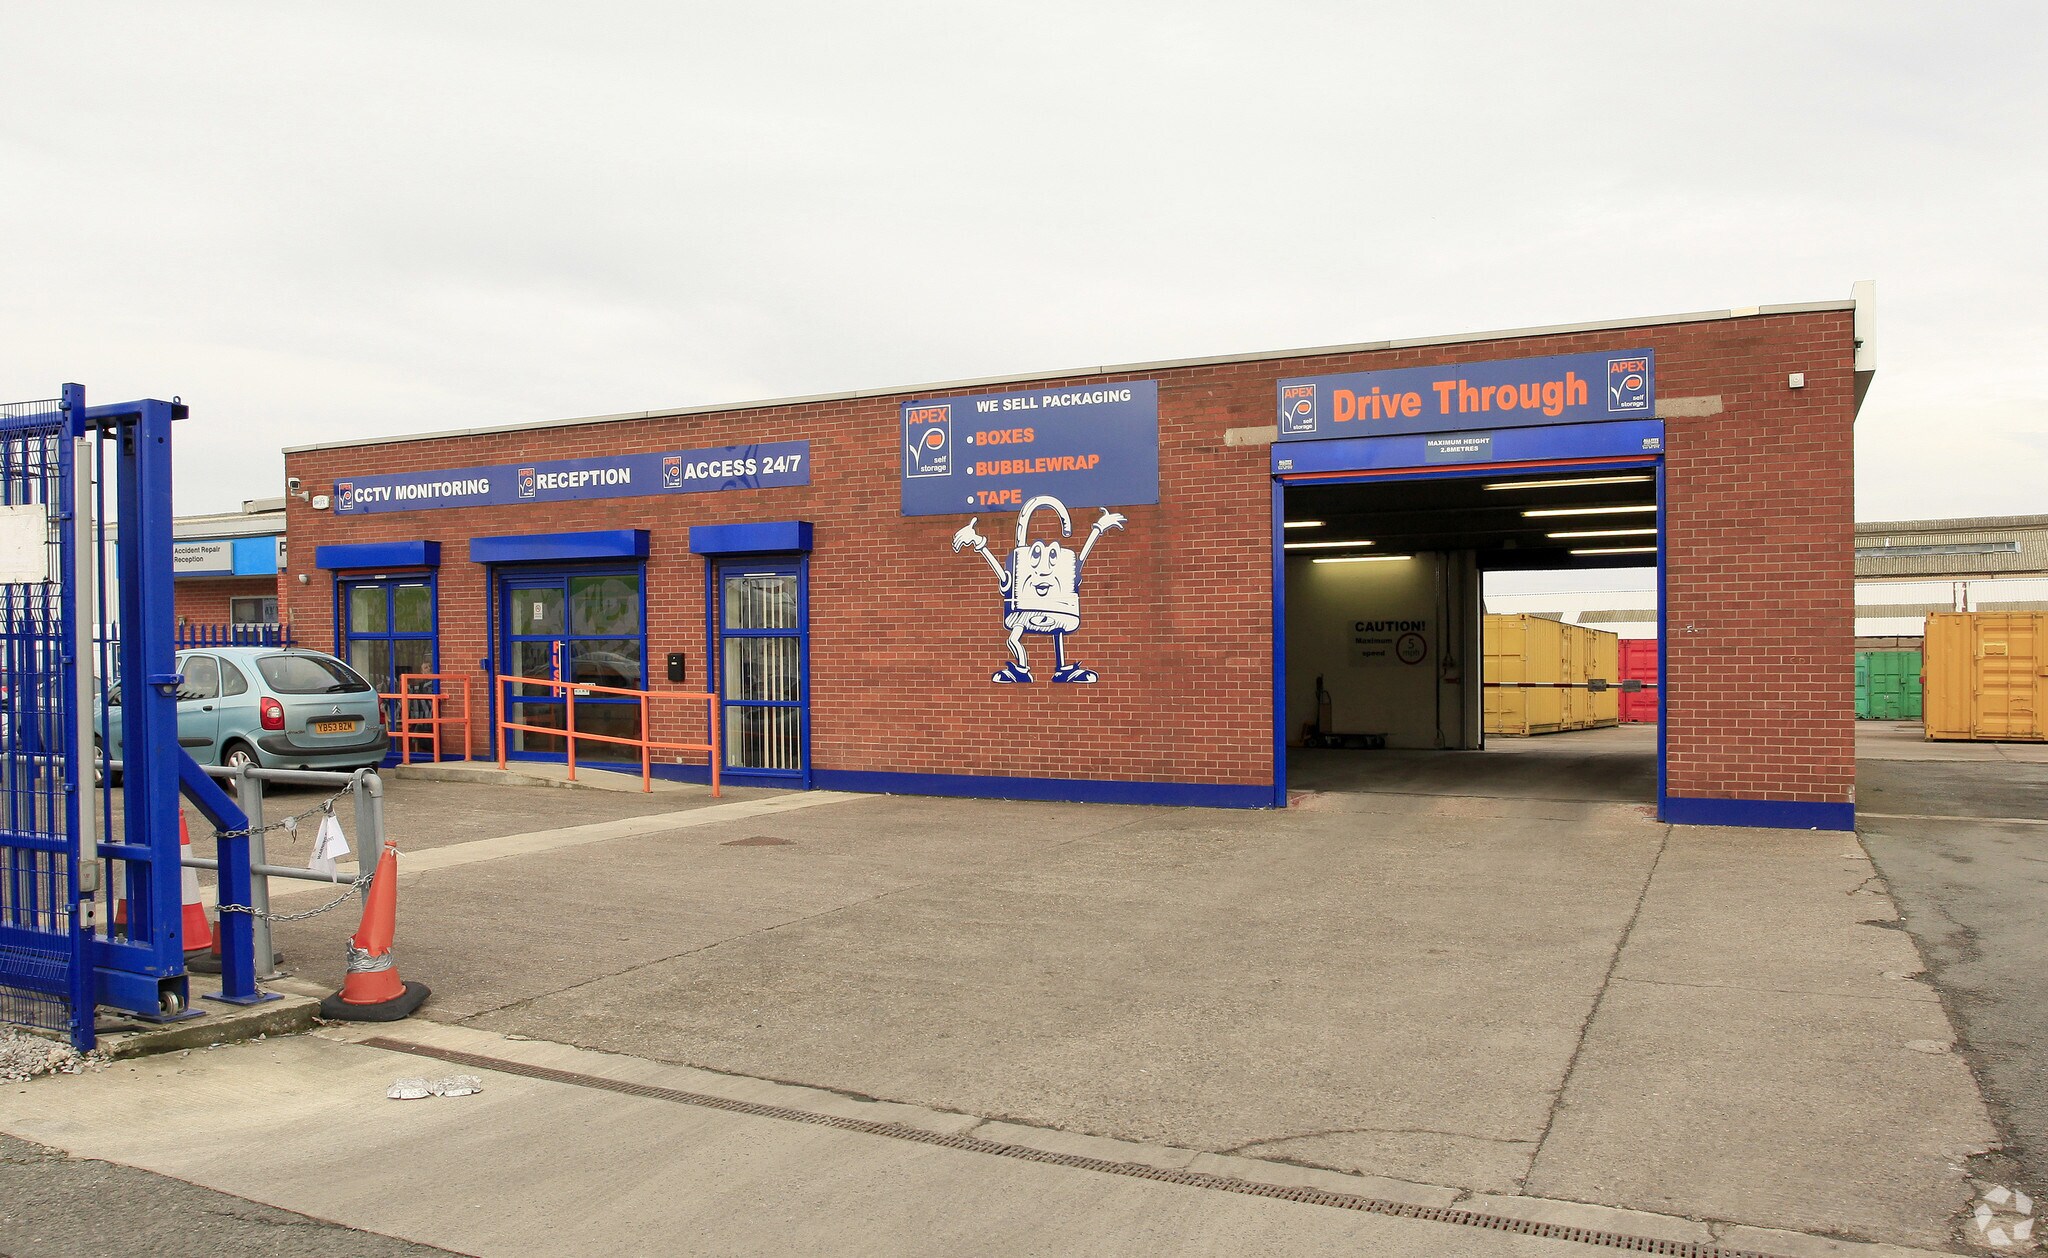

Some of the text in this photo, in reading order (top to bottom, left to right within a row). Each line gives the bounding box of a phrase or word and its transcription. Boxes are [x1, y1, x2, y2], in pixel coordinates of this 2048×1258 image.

[1611, 360, 1646, 374] APEX
[1284, 387, 1313, 399] APEX
[1332, 371, 1588, 422] Drive Through
[976, 389, 1132, 413] WE SELL PACKAGING
[1620, 400, 1644, 408] storage
[909, 408, 948, 425] APEX
[976, 427, 1035, 446] BOXES
[1463, 437, 1490, 445] HEIGHT
[933, 455, 947, 464] self
[976, 454, 1100, 477] BUBBLEWRAP
[684, 455, 801, 480] ACCESS 24/7
[920, 463, 947, 473] storage
[536, 468, 631, 490] RECEPTION
[354, 478, 489, 503] CCTV MONITORING
[976, 489, 1022, 506] TAPE
[201, 546, 221, 554] Repair
[174, 556, 204, 564] Reception
[1354, 621, 1426, 632] CAUTION!
[1407, 638, 1415, 649] 5
[318, 723, 337, 732] YB53
